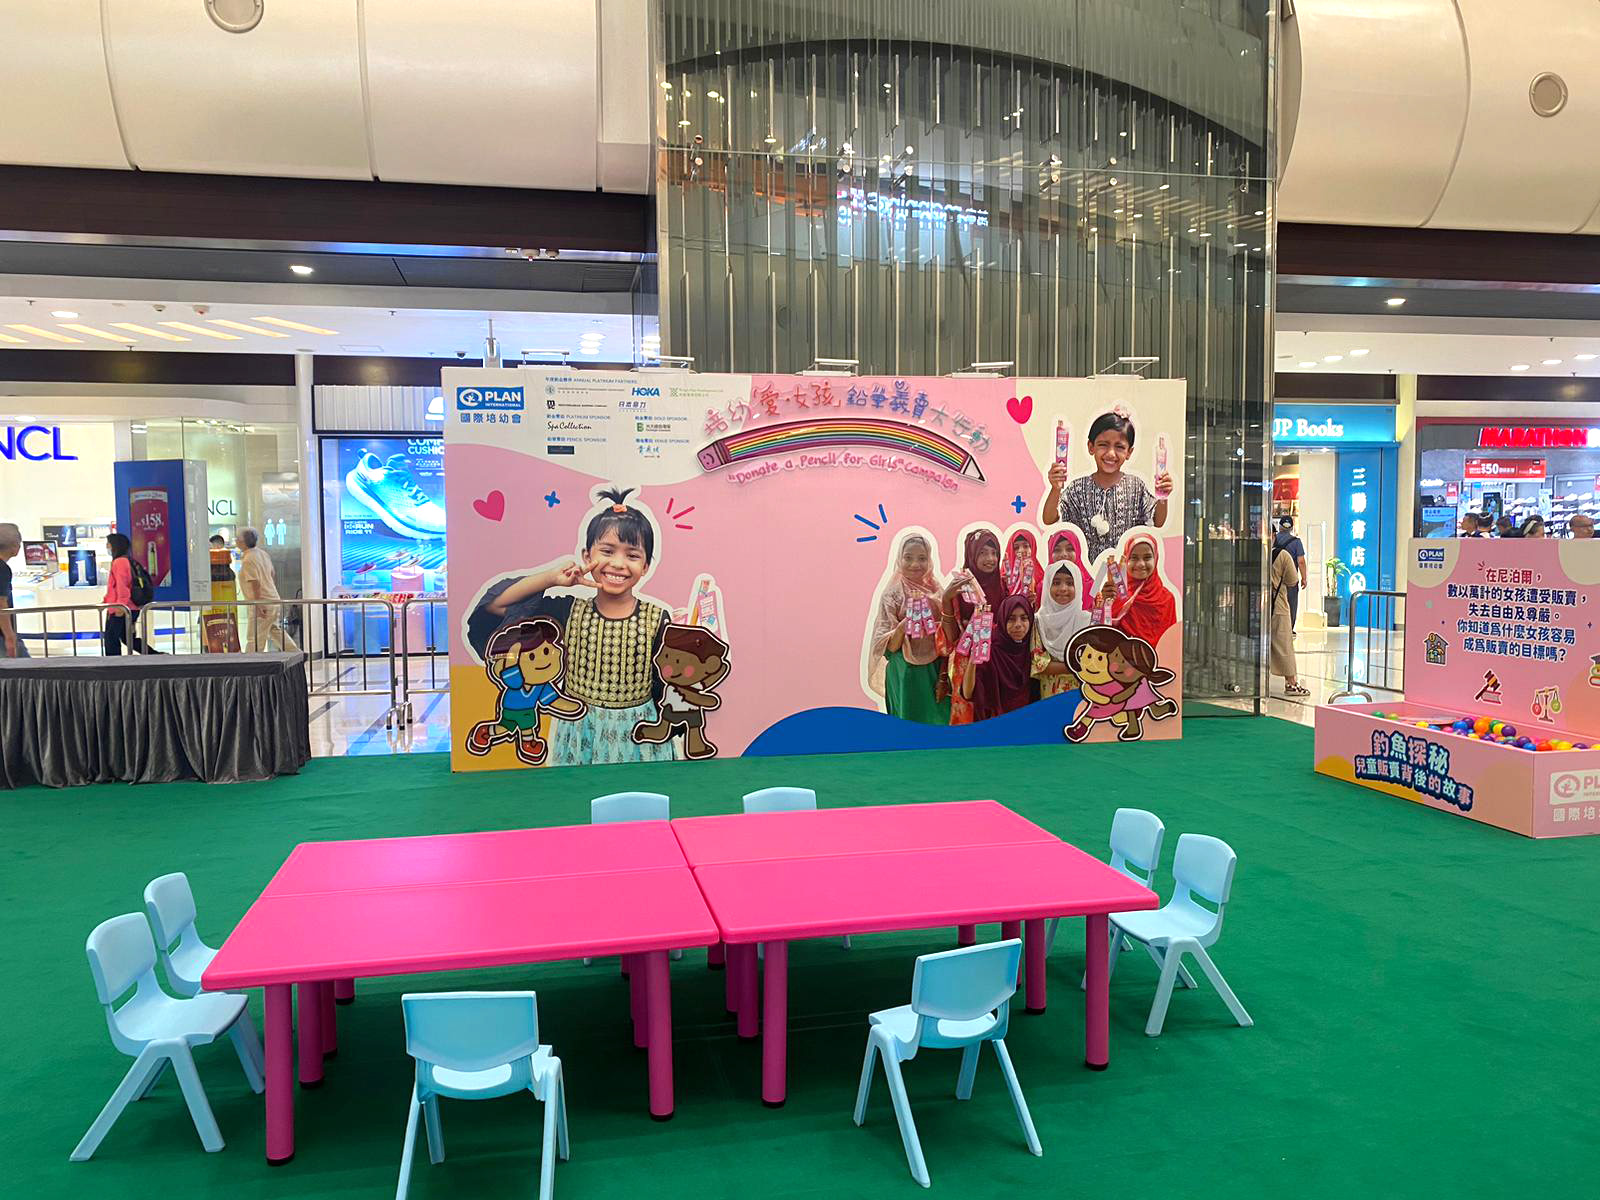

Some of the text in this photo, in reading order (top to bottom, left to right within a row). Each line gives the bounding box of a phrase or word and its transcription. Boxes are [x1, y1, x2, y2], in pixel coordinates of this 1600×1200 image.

[484, 391, 521, 402] PLAN
[631, 387, 660, 397] HOKA
[460, 412, 521, 424] 國際培幼會
[547, 420, 592, 431] Spa Collection
[1296, 417, 1344, 437] Books
[1478, 428, 1588, 447] MARATHON
[785, 460, 794, 469] a
[800, 453, 837, 467] Pencil
[843, 452, 864, 466] for
[1373, 732, 1448, 775] 釣魚探秘
[1553, 806, 1600, 822] 國際培
